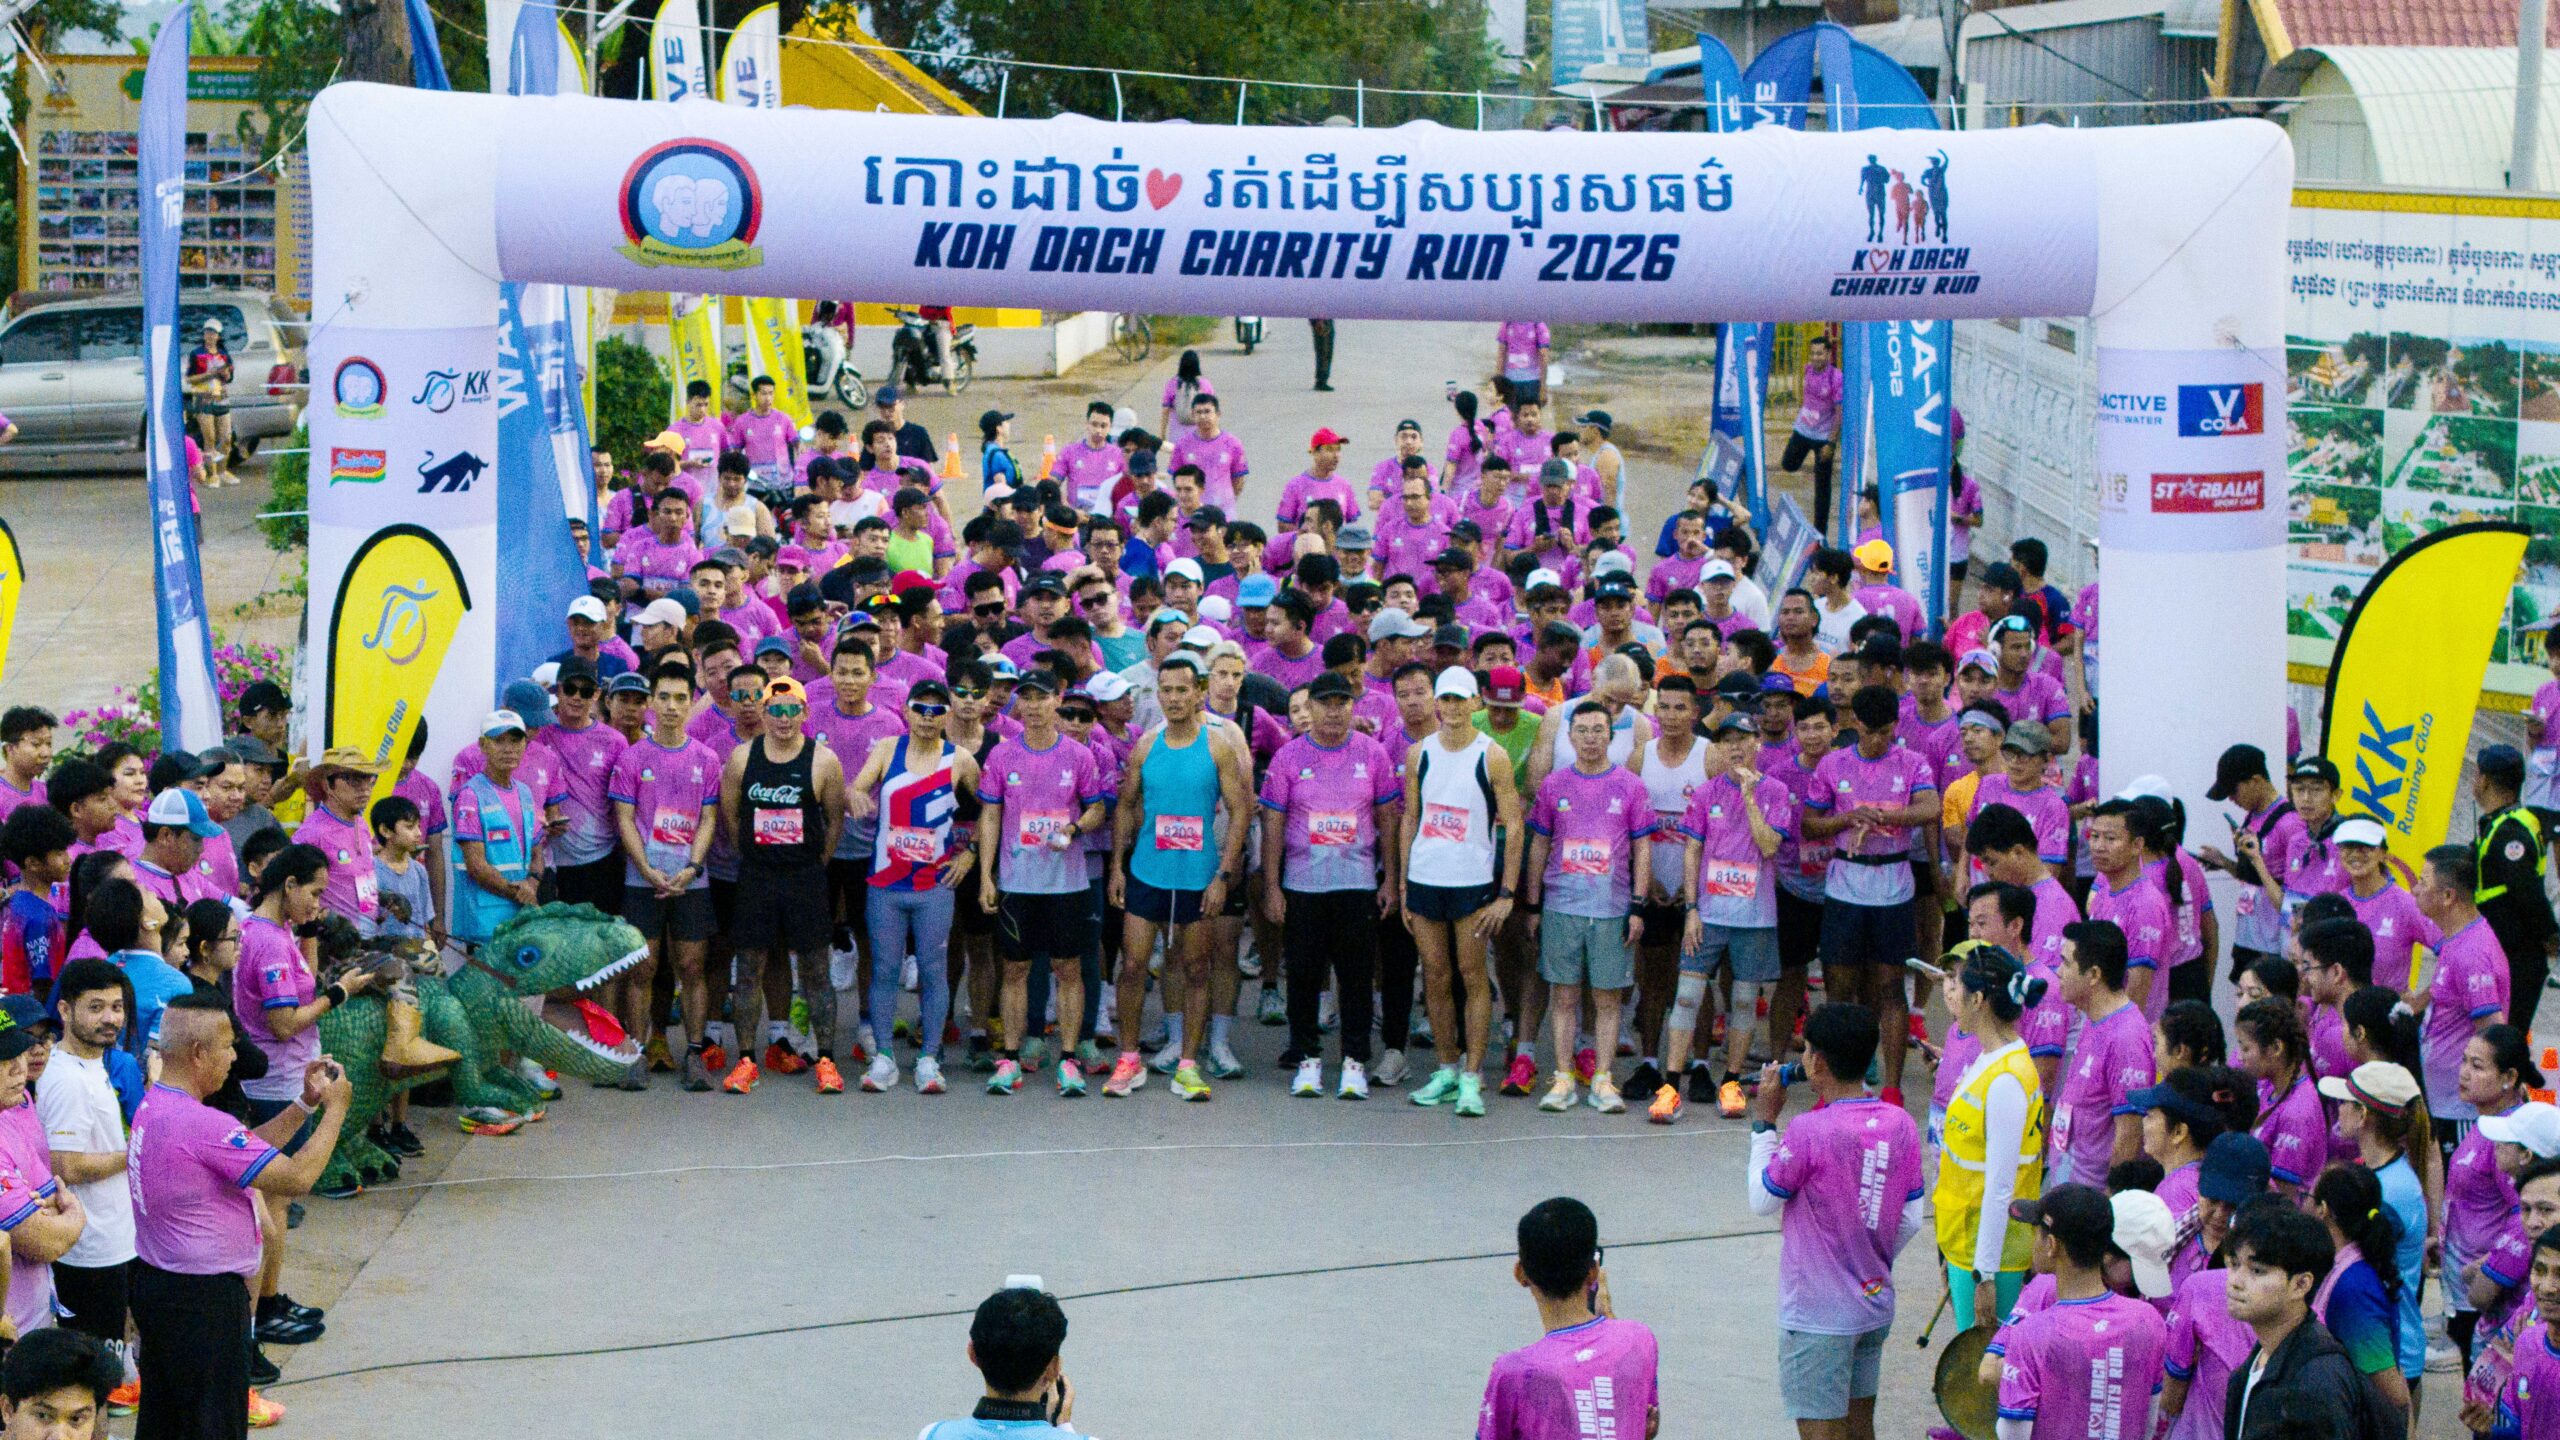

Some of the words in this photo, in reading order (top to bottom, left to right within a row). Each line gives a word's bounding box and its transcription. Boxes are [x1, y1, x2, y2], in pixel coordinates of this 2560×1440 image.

[863, 146, 1140, 213] កោះដាច់
[914, 221, 1017, 270] KOH
[1029, 225, 1165, 275] DACH
[1179, 229, 1393, 281] CHARITY
[1405, 233, 1511, 281] RUN
[1537, 233, 1680, 282] 2026
[1908, 247, 1970, 270] DACH
[1830, 277, 1927, 296] CHARITY
[1933, 275, 1981, 294] RUN
[464, 369, 491, 395] KK
[2208, 389, 2241, 417] V
[2125, 415, 2162, 425] WATER
[2200, 416, 2248, 432] COLA
[386, 699, 408, 735] Club
[2351, 698, 2415, 826] KK
[2397, 760, 2428, 836] Running
[2415, 711, 2434, 754] Club
[1716, 871, 1747, 884] 8151
[2108, 1347, 2123, 1378] RUN
[1594, 1376, 1614, 1410] RUN
[1574, 1389, 1597, 1434] DACH
[2103, 1384, 2122, 1440] HARITY
